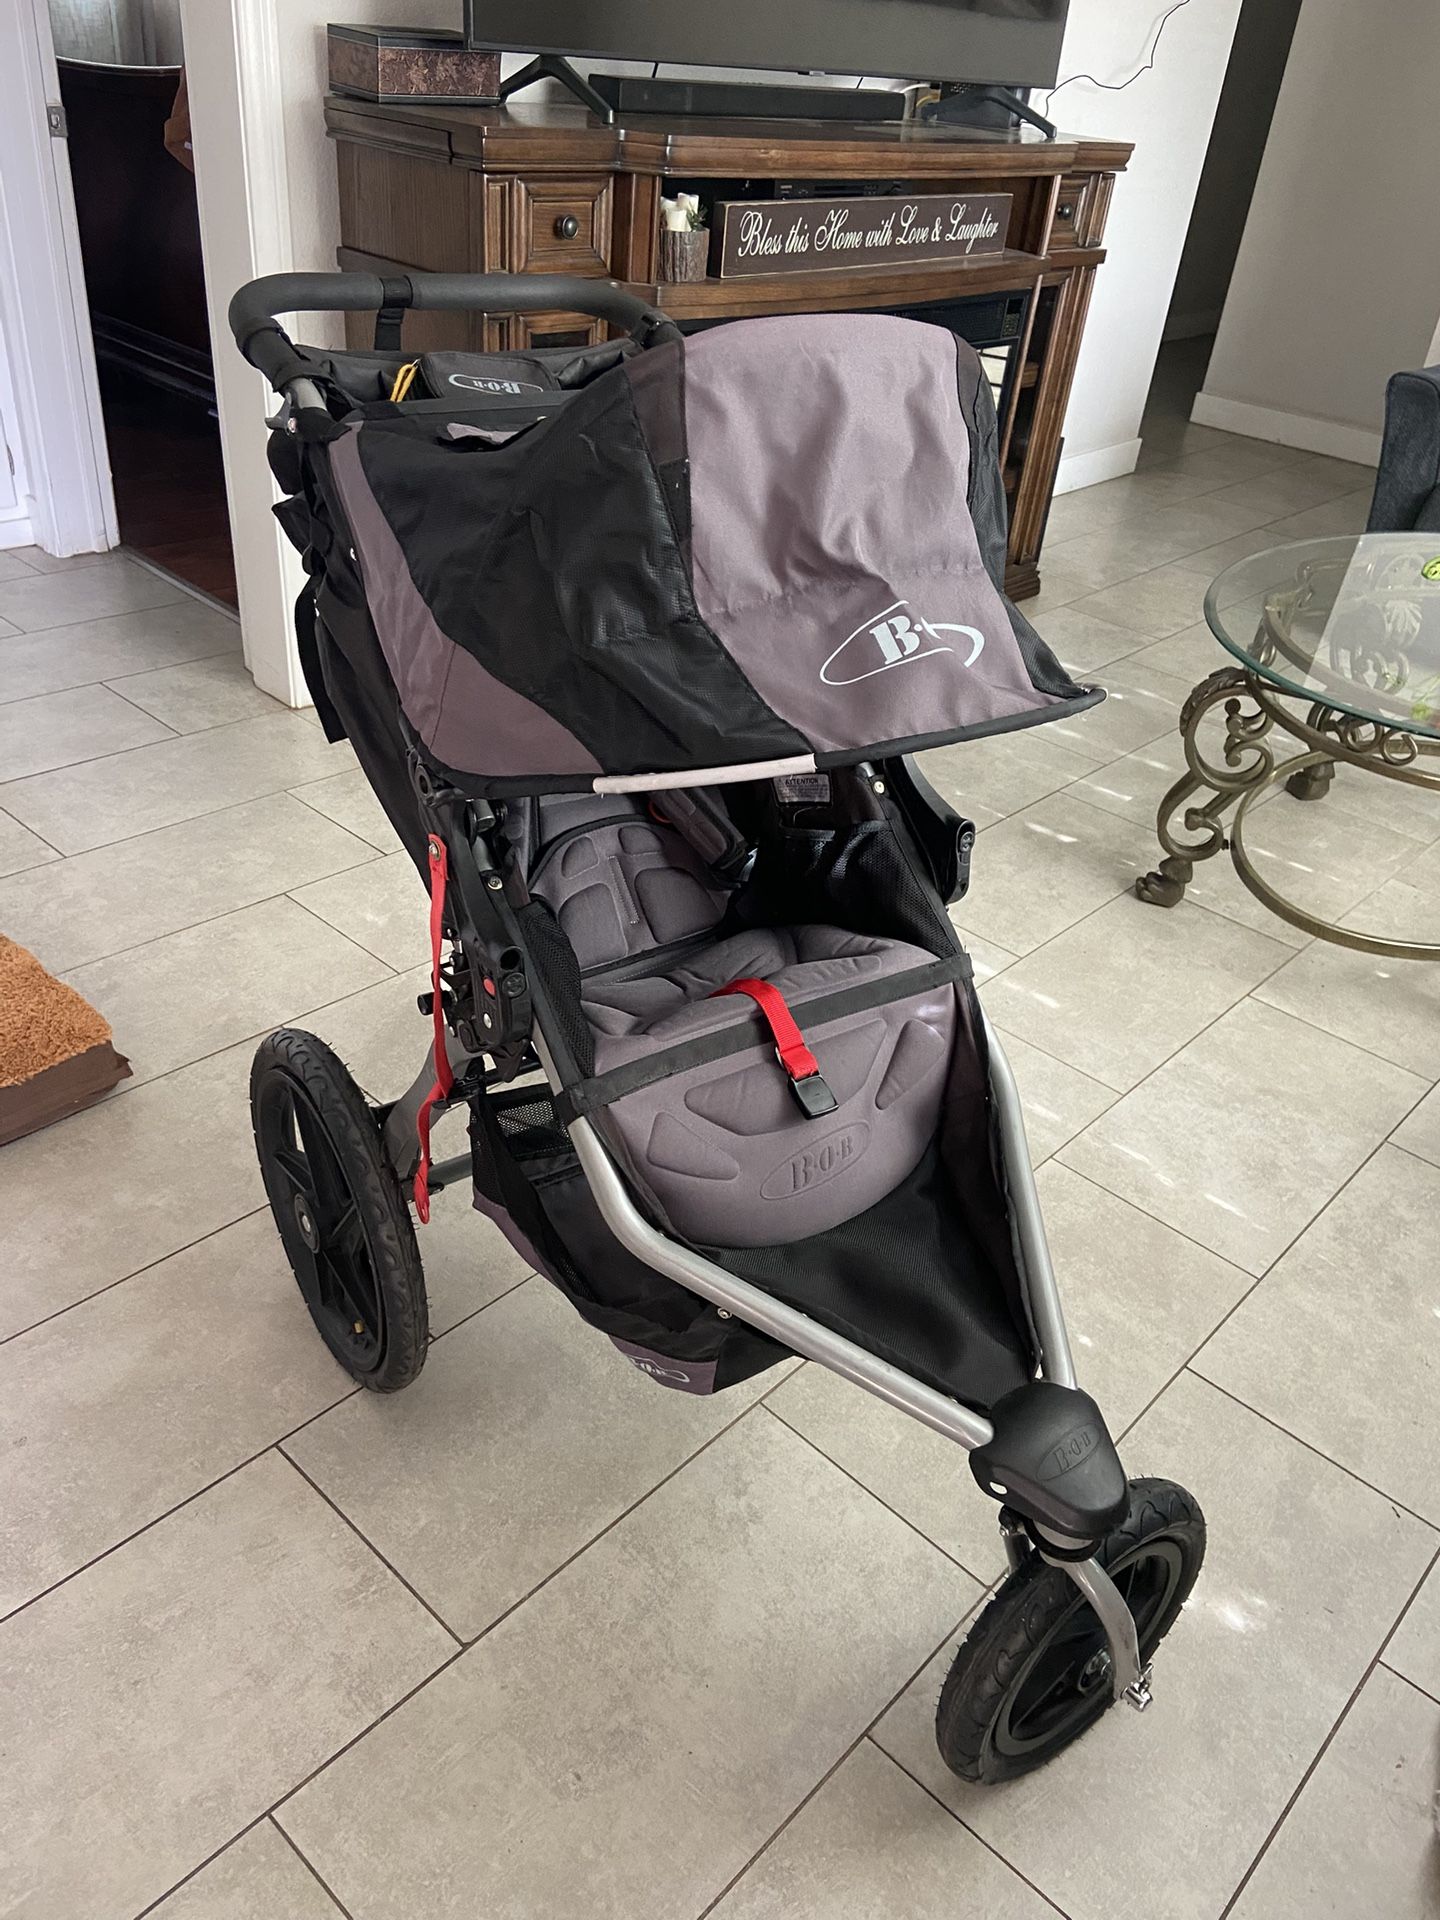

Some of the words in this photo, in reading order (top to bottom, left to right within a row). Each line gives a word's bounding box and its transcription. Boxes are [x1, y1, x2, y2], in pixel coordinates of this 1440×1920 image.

[738, 211, 783, 257] Bless
[785, 217, 810, 254] this
[814, 208, 863, 251] Home
[865, 212, 893, 248] with
[895, 204, 930, 245] Love
[931, 217, 942, 241] &
[945, 203, 999, 254] Laughter
